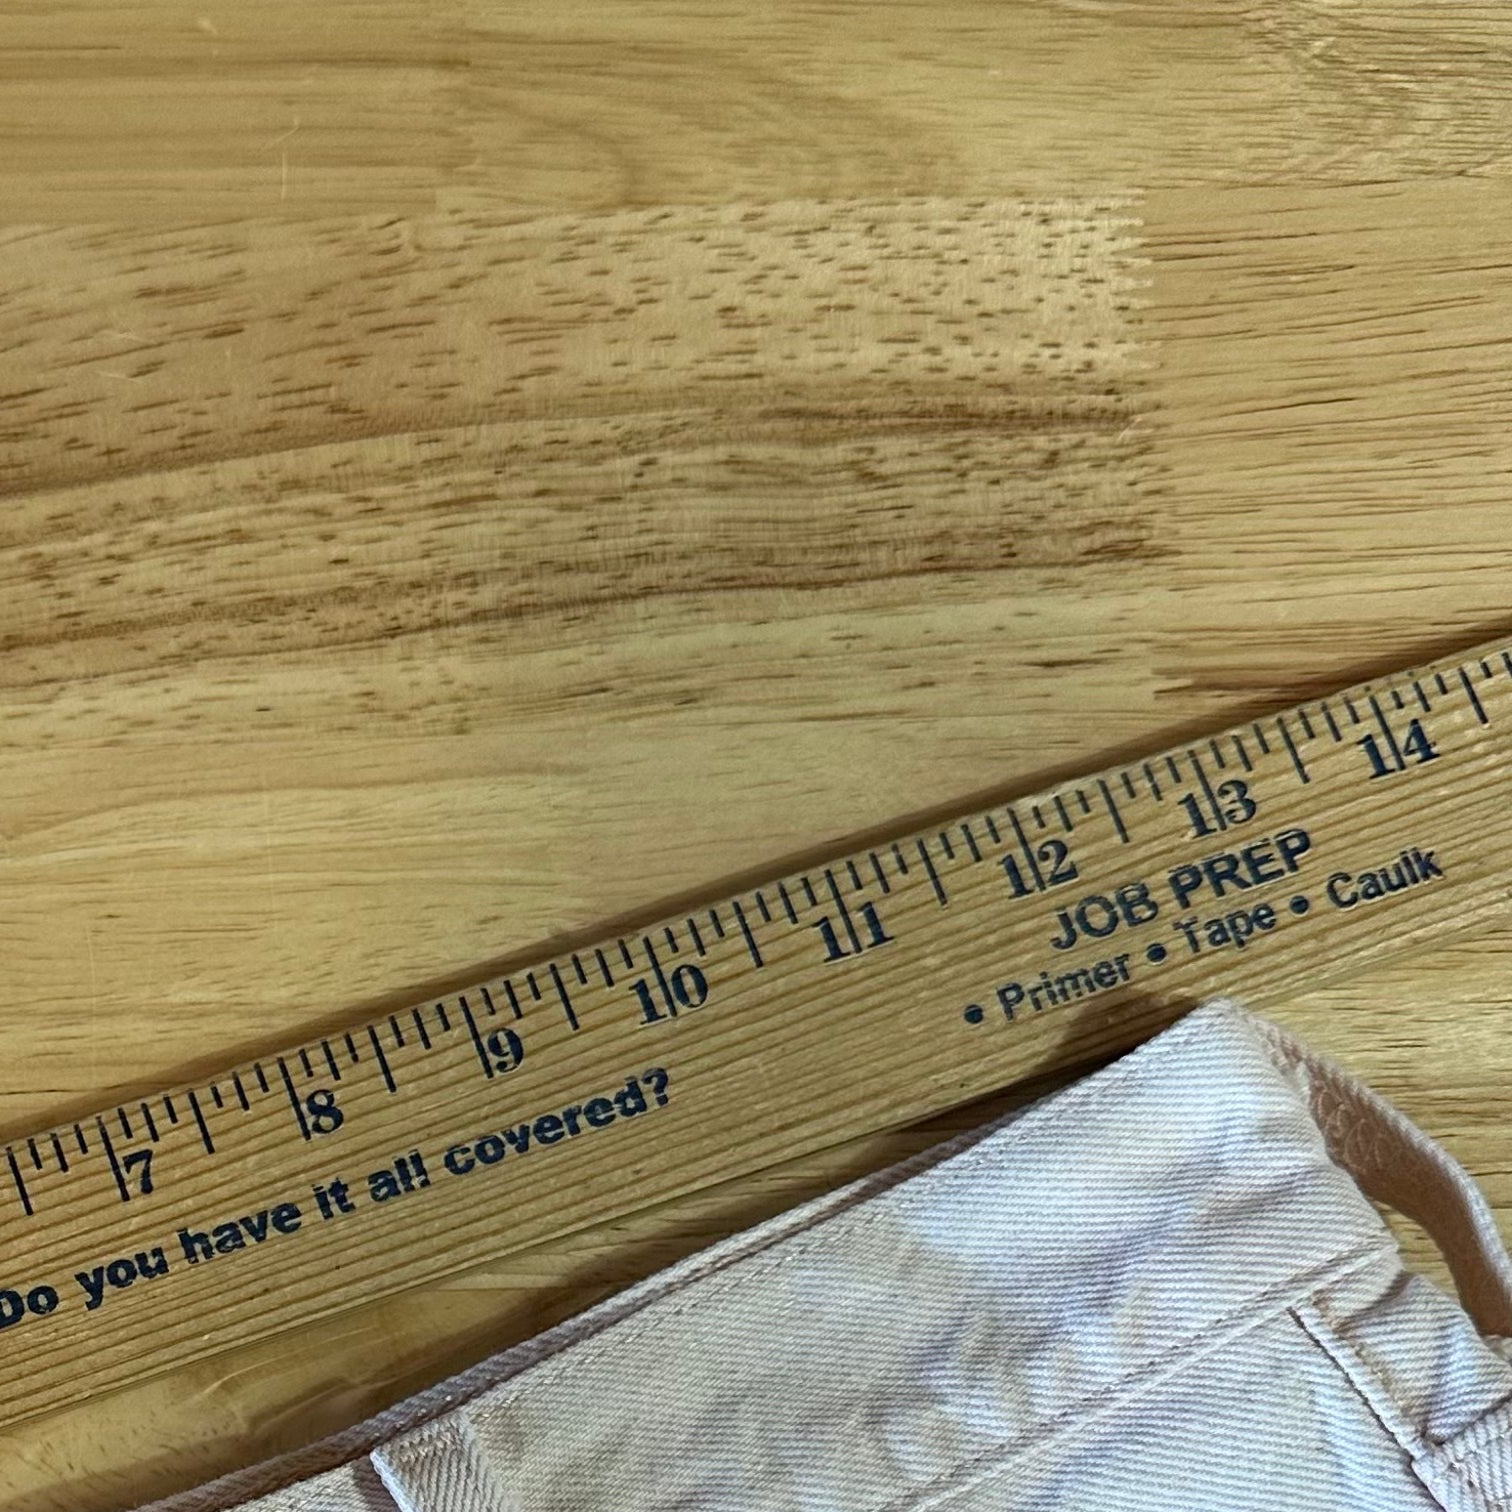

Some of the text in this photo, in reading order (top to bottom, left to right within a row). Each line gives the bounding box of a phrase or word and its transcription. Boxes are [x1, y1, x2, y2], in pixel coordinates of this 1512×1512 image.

[123, 1150, 154, 1194] 7
[307, 1089, 344, 1134] 8
[489, 1028, 524, 1073] 9
[630, 964, 709, 1026] 10
[812, 900, 894, 962] 11
[998, 839, 1078, 898] 12
[1179, 779, 1257, 839] 13
[1356, 720, 1439, 780] 14
[997, 845, 1444, 1021] Primer Tape Caulk
[1050, 827, 1311, 951] JOB PREP
[75, 1246, 168, 1310] you
[179, 1194, 302, 1264] have
[314, 1179, 354, 1219] it
[368, 1149, 429, 1202] all
[444, 1067, 669, 1175] covered?
